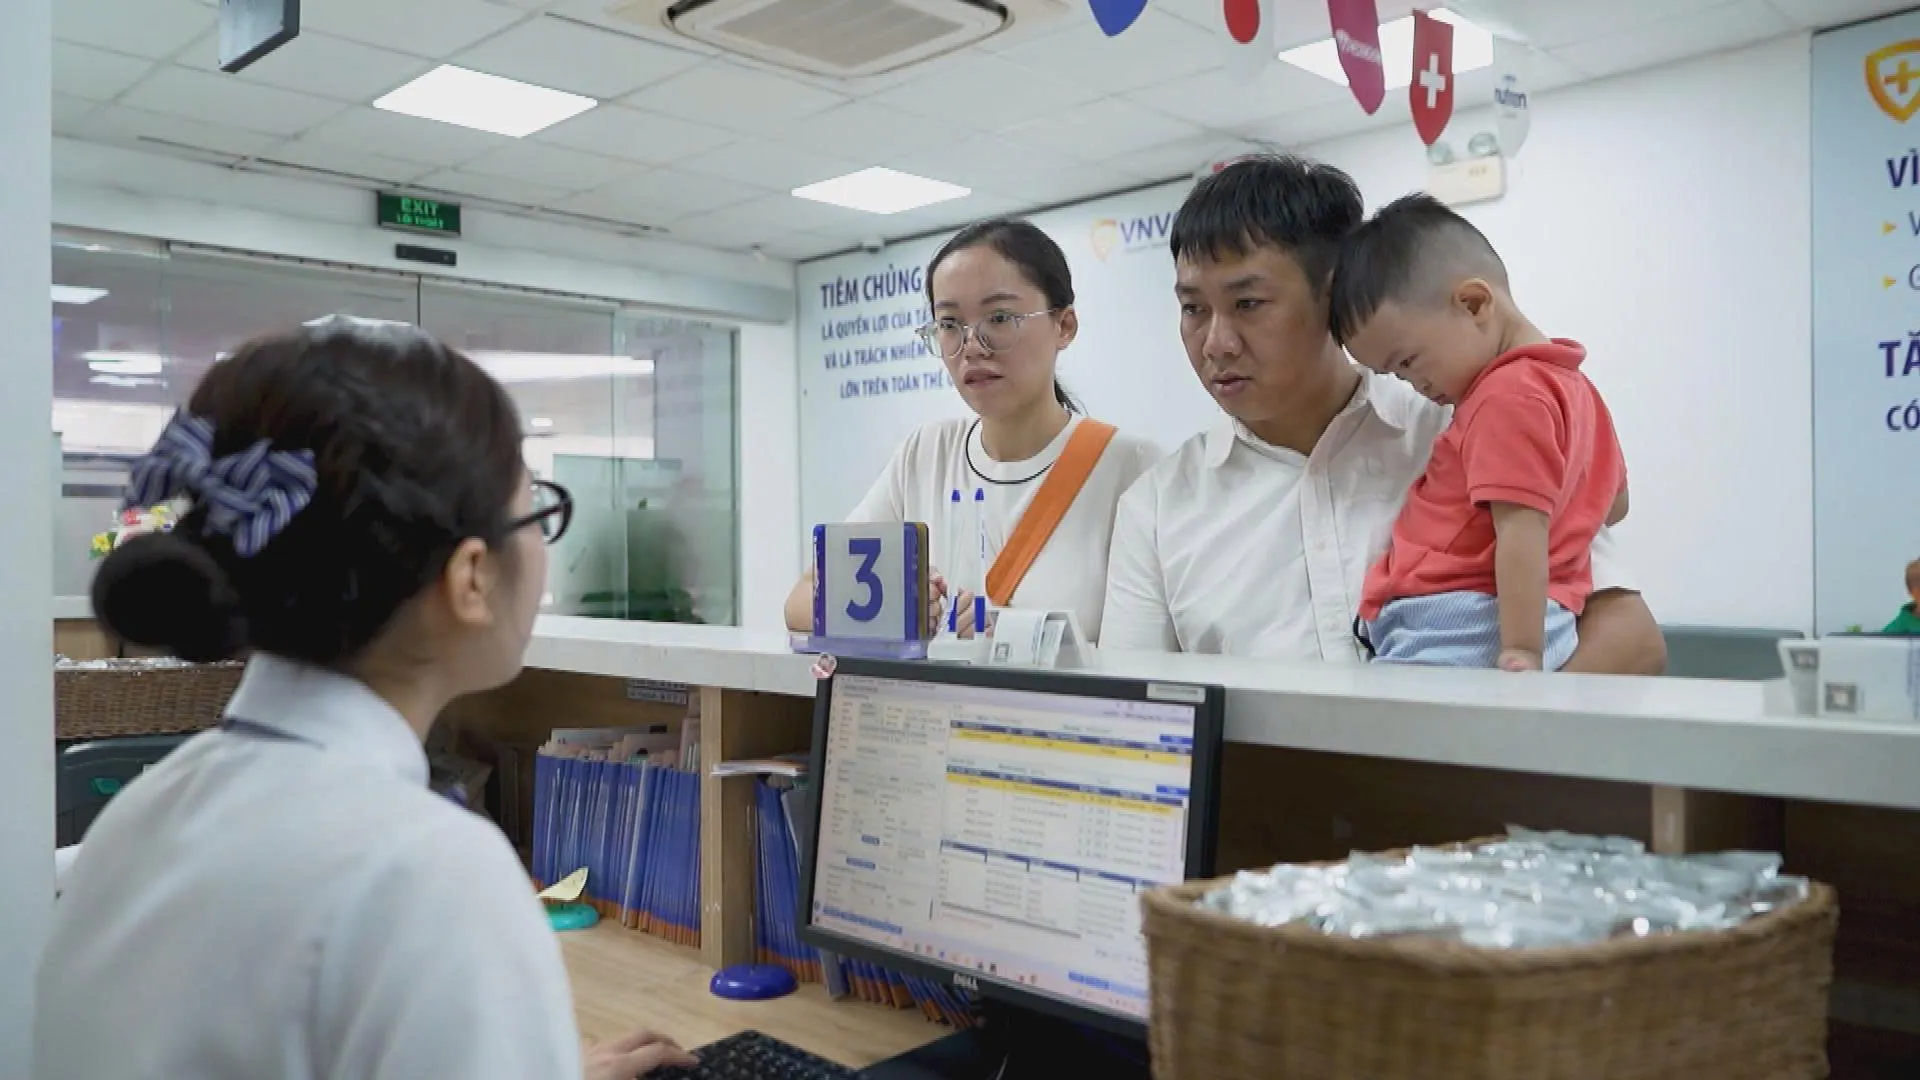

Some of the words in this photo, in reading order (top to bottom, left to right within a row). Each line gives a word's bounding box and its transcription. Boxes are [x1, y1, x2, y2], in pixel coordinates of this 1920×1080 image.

[401, 195, 438, 217] EXIT
[820, 275, 859, 309] TIÊM
[863, 263, 922, 302] CHỦNG
[846, 537, 884, 623] 3
